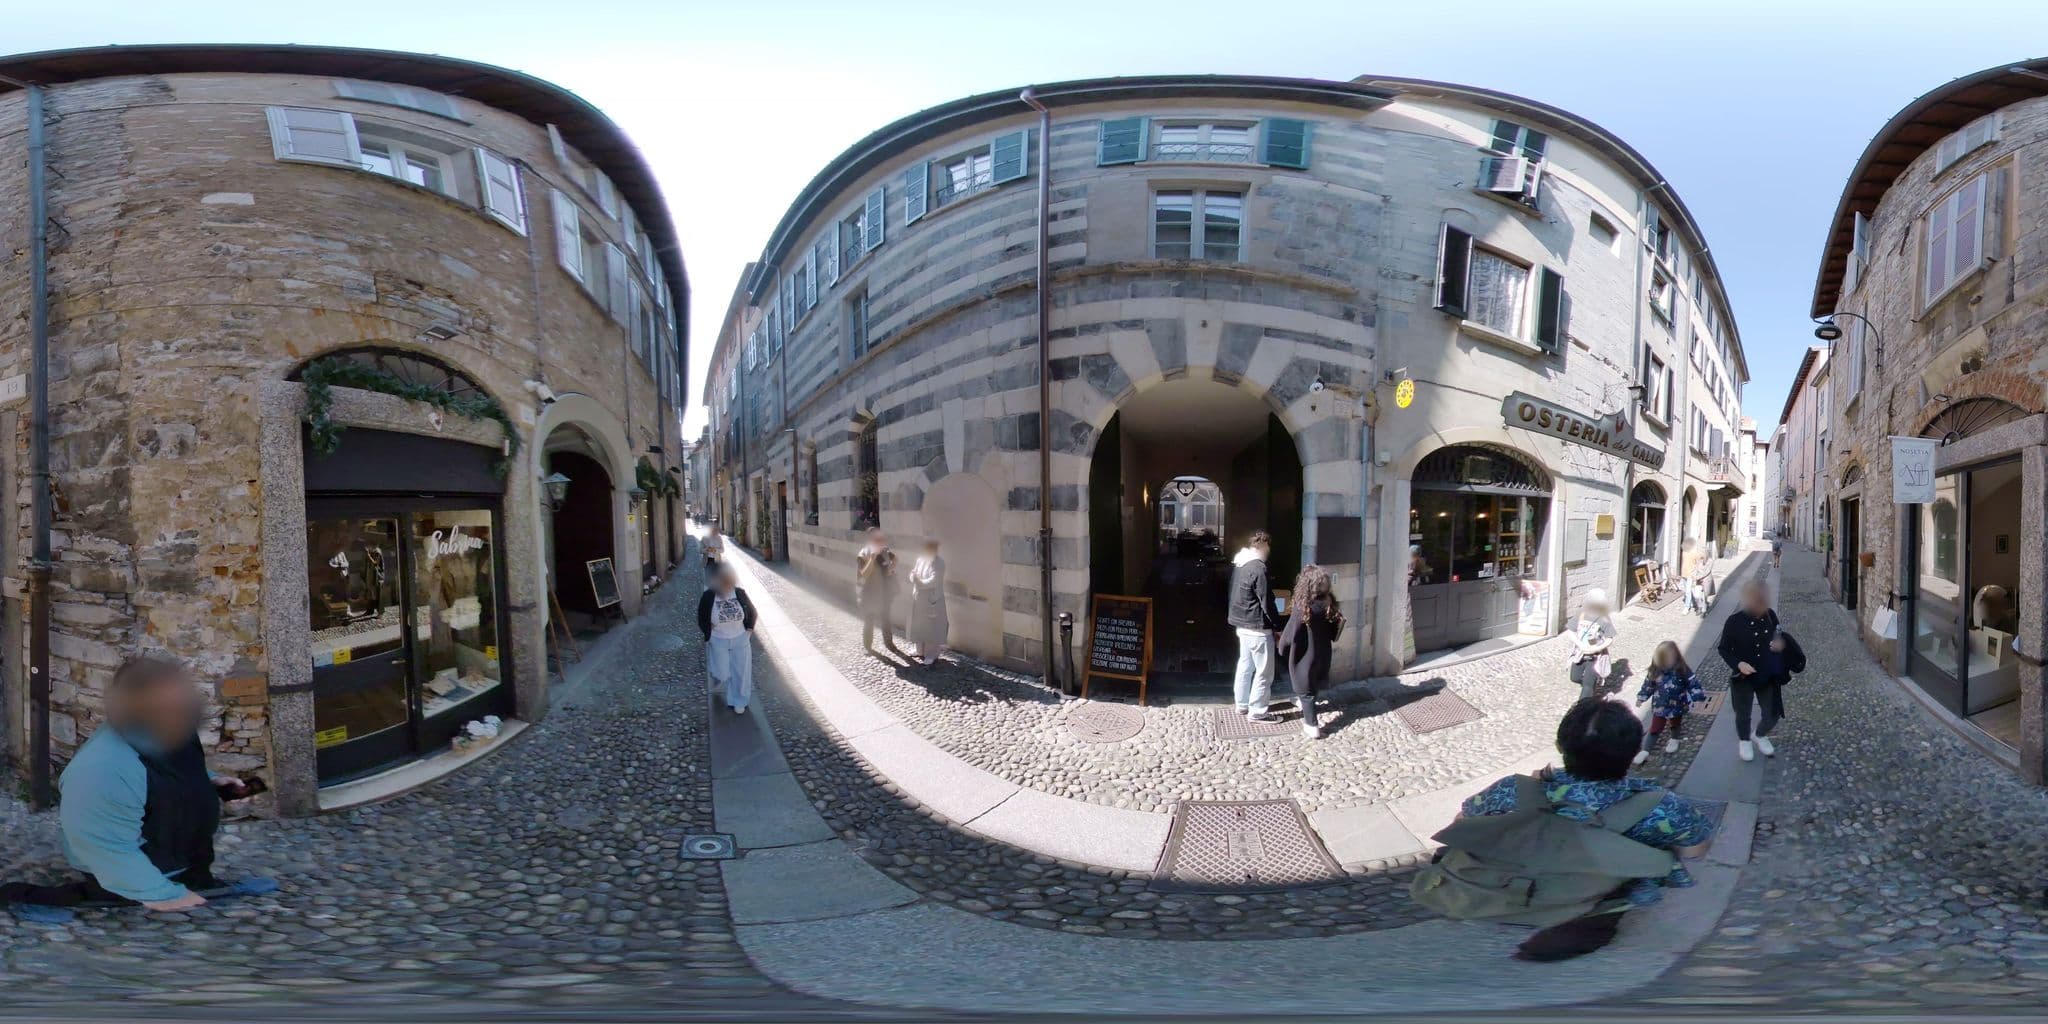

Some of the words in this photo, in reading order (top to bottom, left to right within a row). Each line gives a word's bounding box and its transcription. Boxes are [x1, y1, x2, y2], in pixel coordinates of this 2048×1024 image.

[7, 381, 18, 394] 19
[1518, 402, 1609, 447] OSTERIA
[1612, 440, 1630, 451] del
[1631, 446, 1661, 467] GALLO
